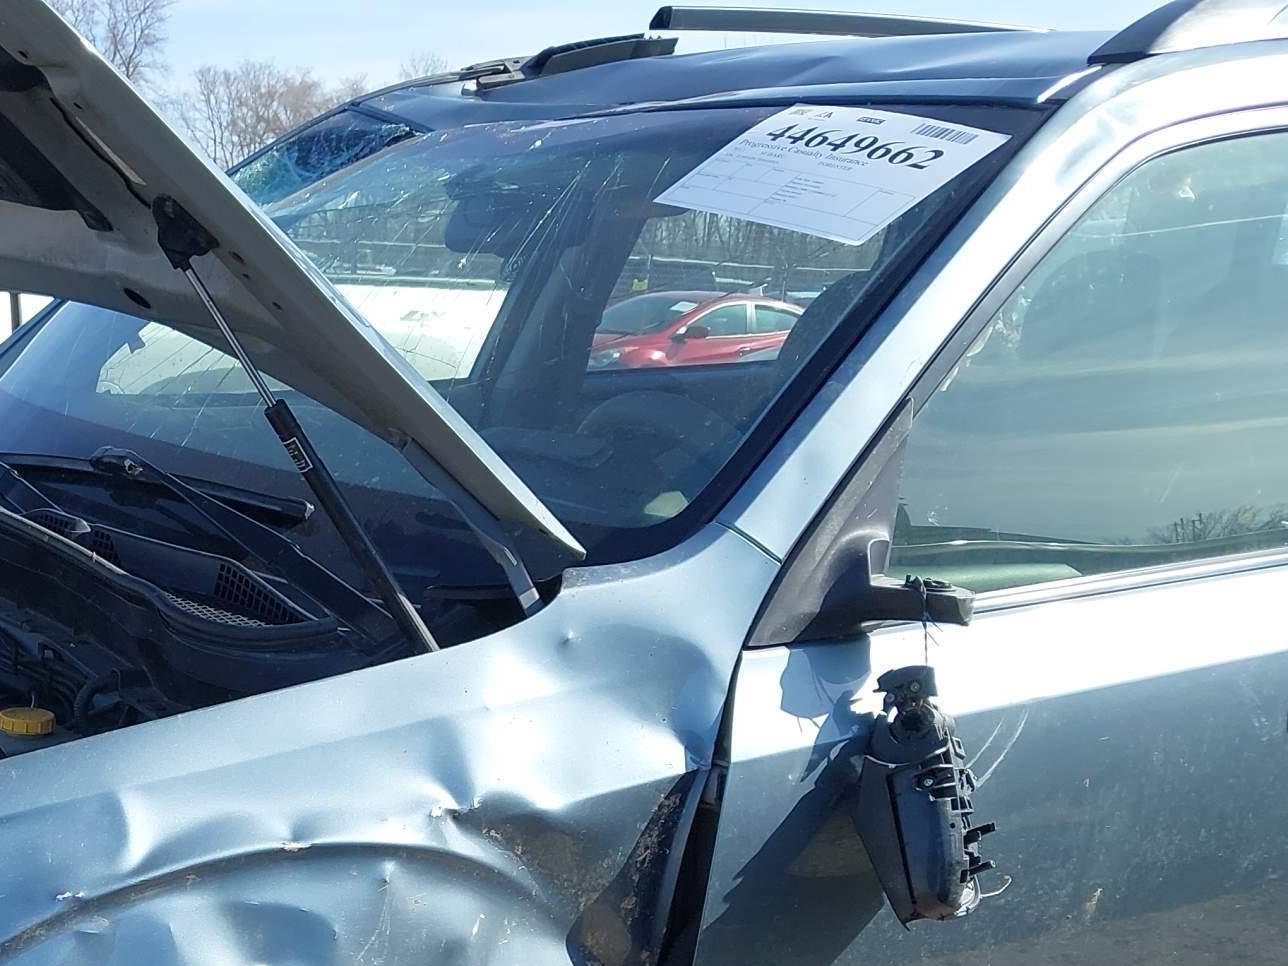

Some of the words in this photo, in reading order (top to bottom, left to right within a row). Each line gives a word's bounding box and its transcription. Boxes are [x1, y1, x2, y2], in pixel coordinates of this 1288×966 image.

[739, 138, 788, 154] Progressive
[825, 153, 870, 167] Insurance
[766, 123, 944, 170] 44649662
